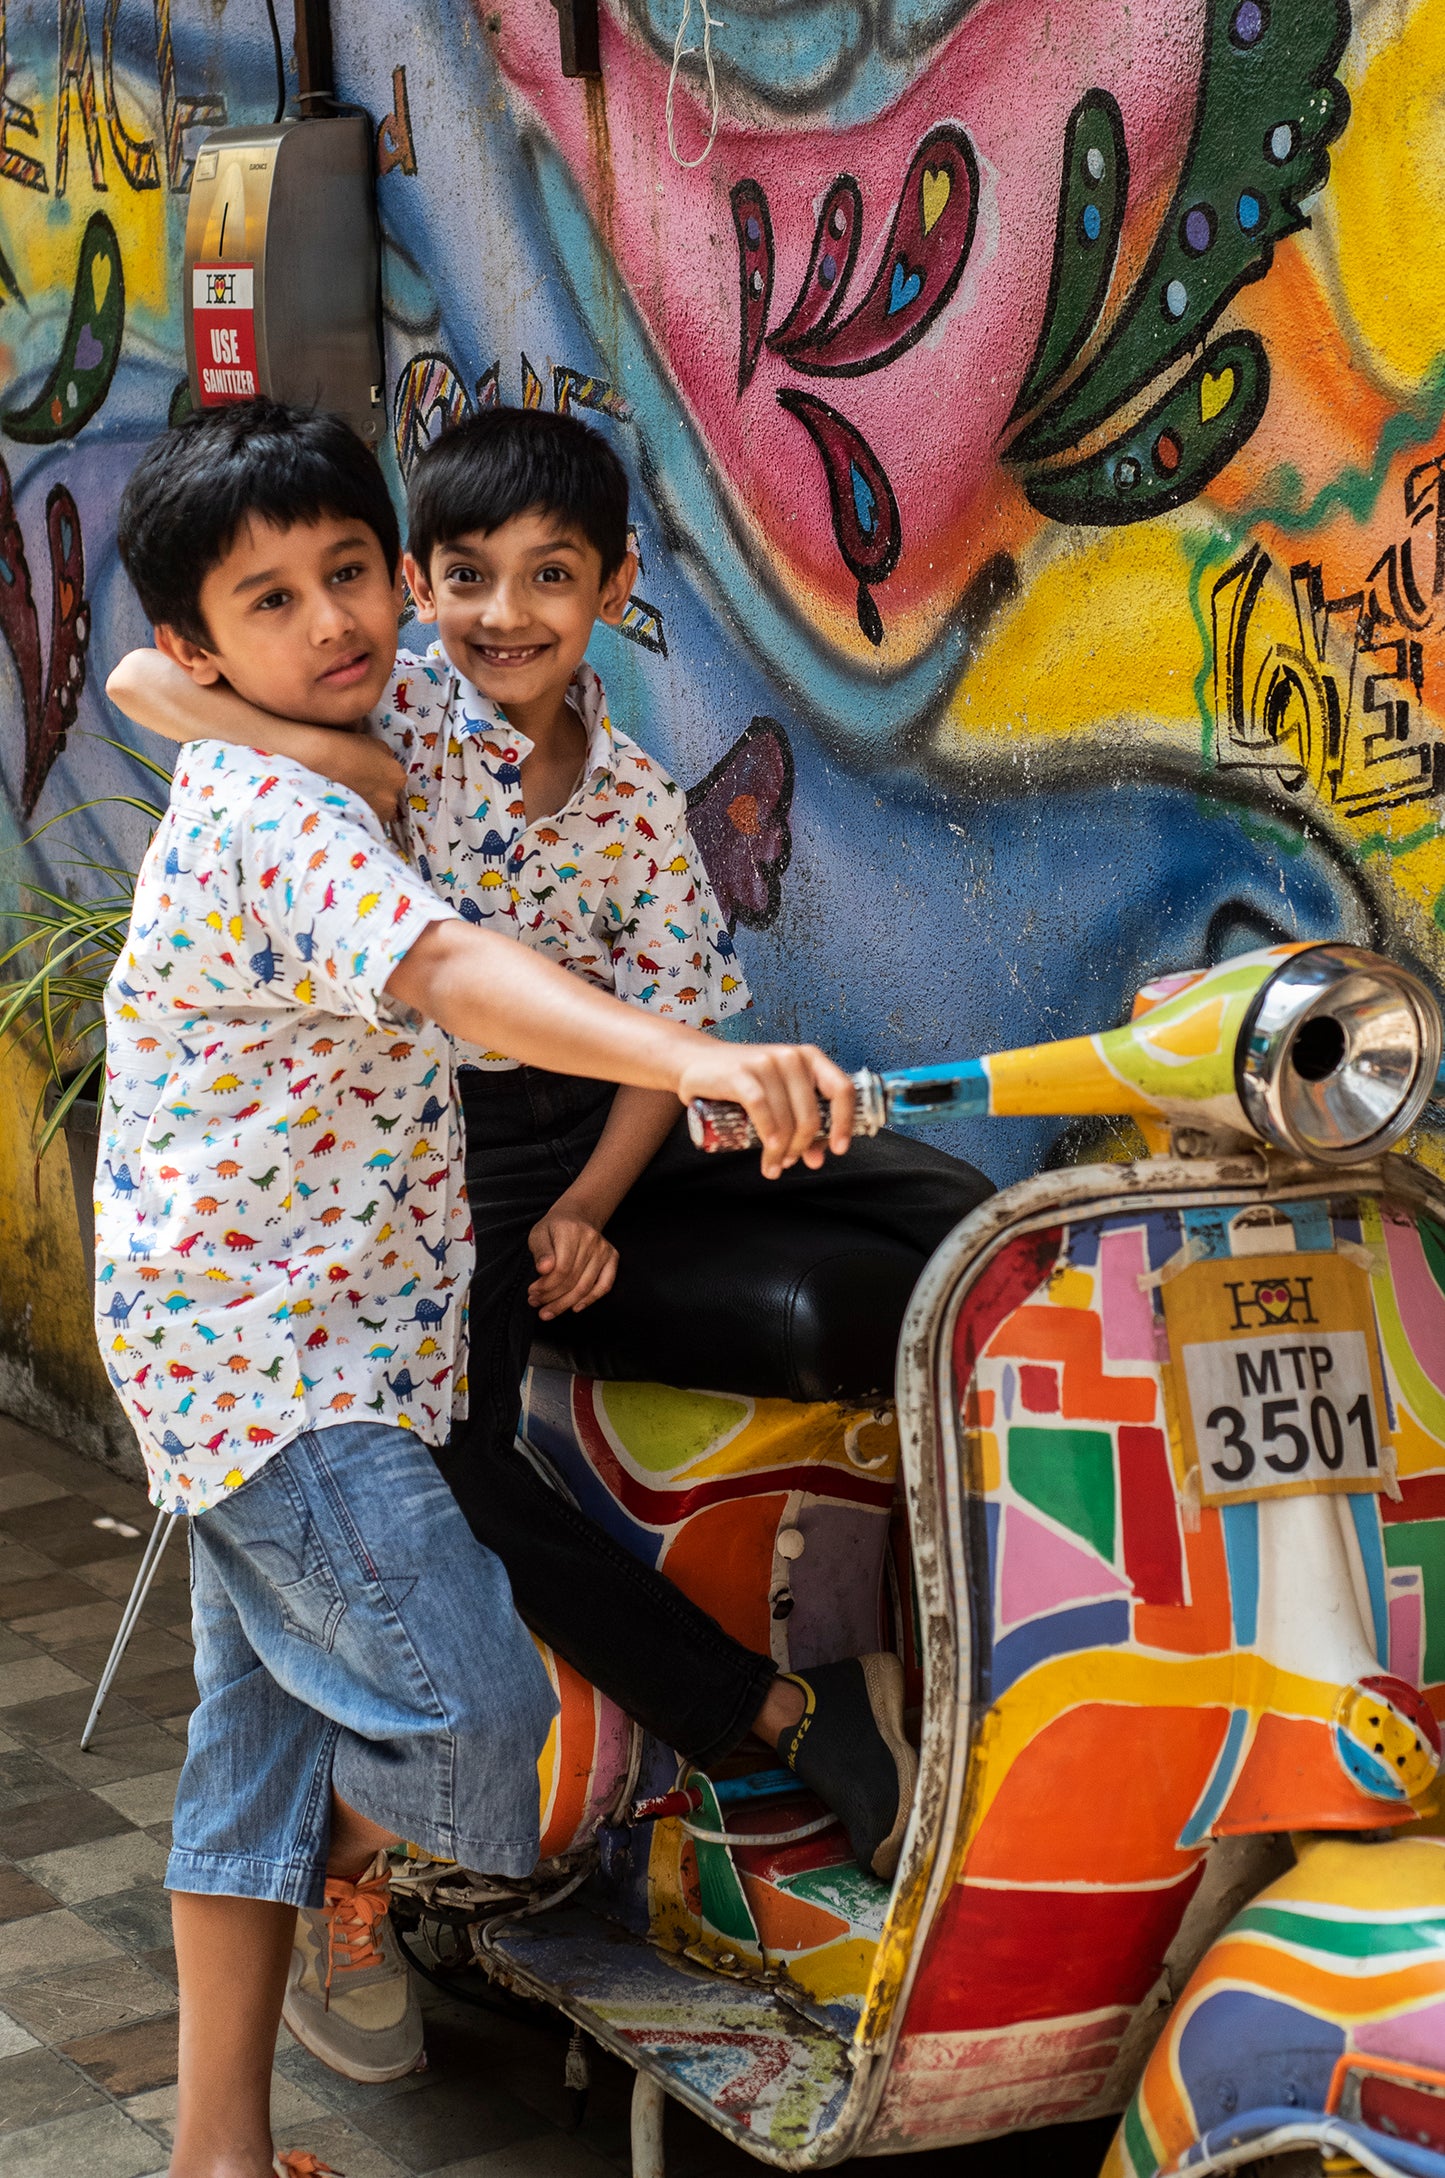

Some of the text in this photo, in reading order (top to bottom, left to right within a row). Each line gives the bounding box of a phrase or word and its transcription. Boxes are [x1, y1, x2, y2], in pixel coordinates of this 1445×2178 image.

[210, 328, 240, 364] USE
[203, 368, 255, 395] SANITIZER
[1236, 1346, 1333, 1397] MTP
[1206, 1394, 1378, 1482] 3501
